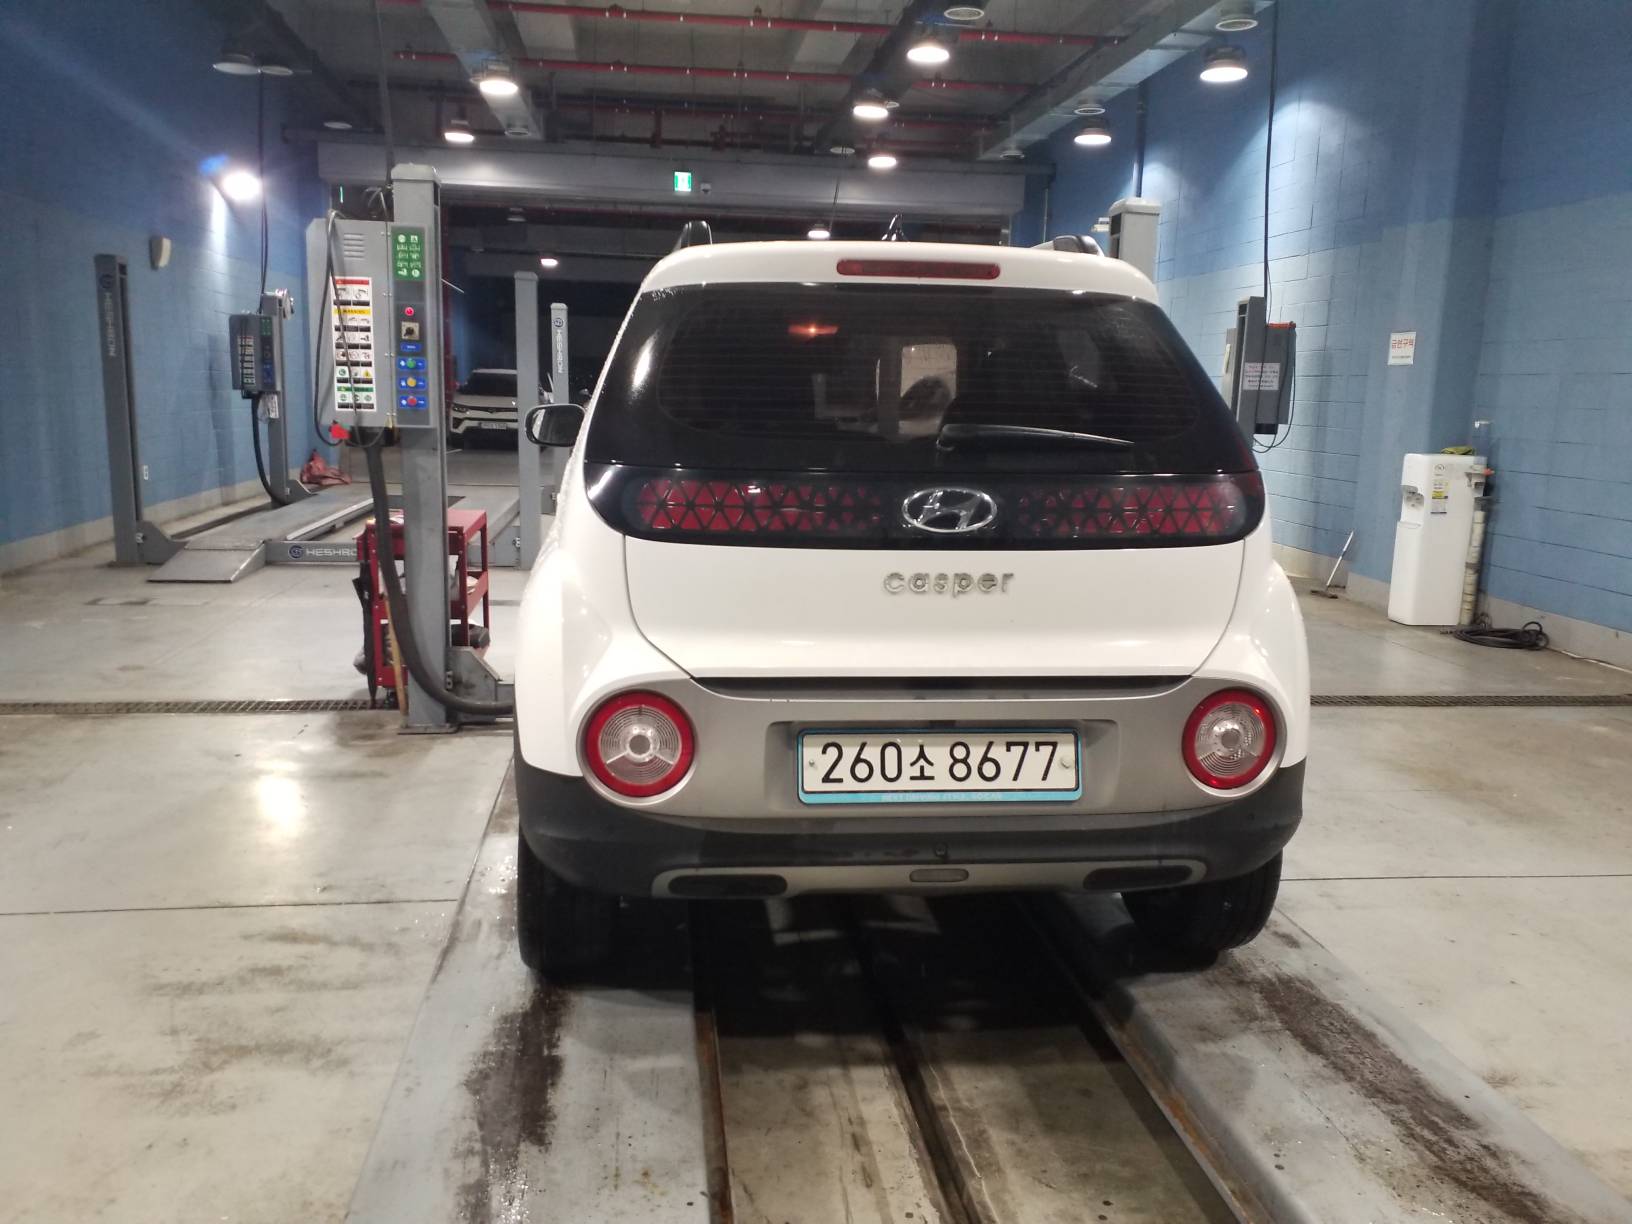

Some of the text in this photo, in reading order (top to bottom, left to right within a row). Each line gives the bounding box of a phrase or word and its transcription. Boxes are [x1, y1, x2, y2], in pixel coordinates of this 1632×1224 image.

[305, 547, 357, 557] HESHBO
[884, 572, 1014, 598] casper
[821, 741, 1058, 783] 260소 8677
